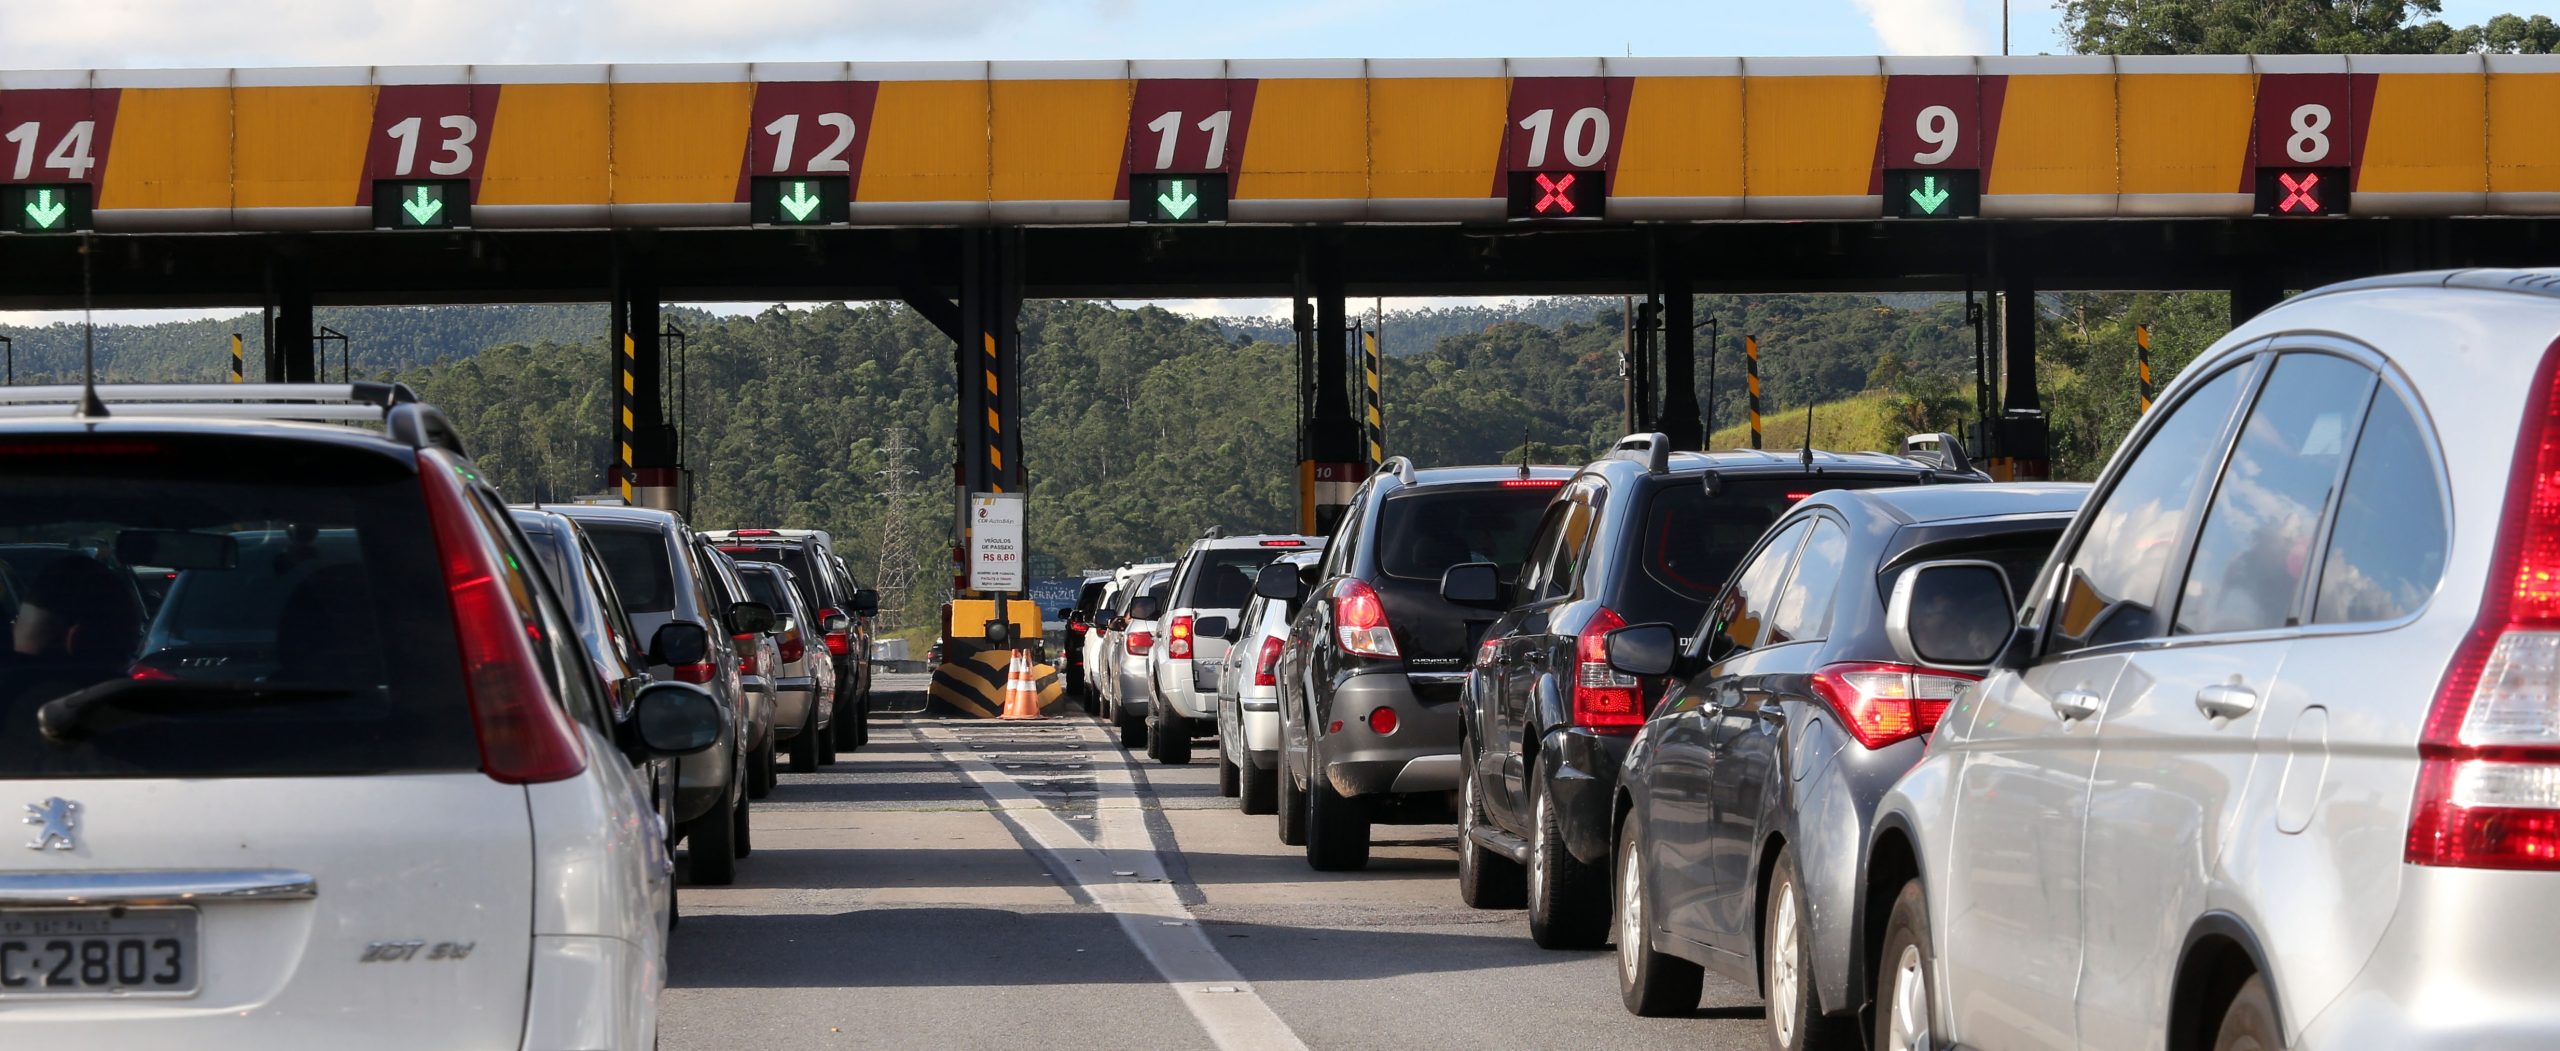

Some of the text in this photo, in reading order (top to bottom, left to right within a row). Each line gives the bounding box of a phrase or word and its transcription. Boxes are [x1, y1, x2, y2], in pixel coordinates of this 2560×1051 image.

[5, 121, 96, 180] 14
[387, 114, 477, 176] 13
[764, 113, 856, 172] 12
[1147, 111, 1232, 170] 11
[1519, 107, 1610, 167] 10
[1913, 105, 1959, 165] 9
[2286, 103, 2332, 163] 8
[1316, 467, 1332, 478] 10
[983, 553, 1015, 562] R$ 8,80
